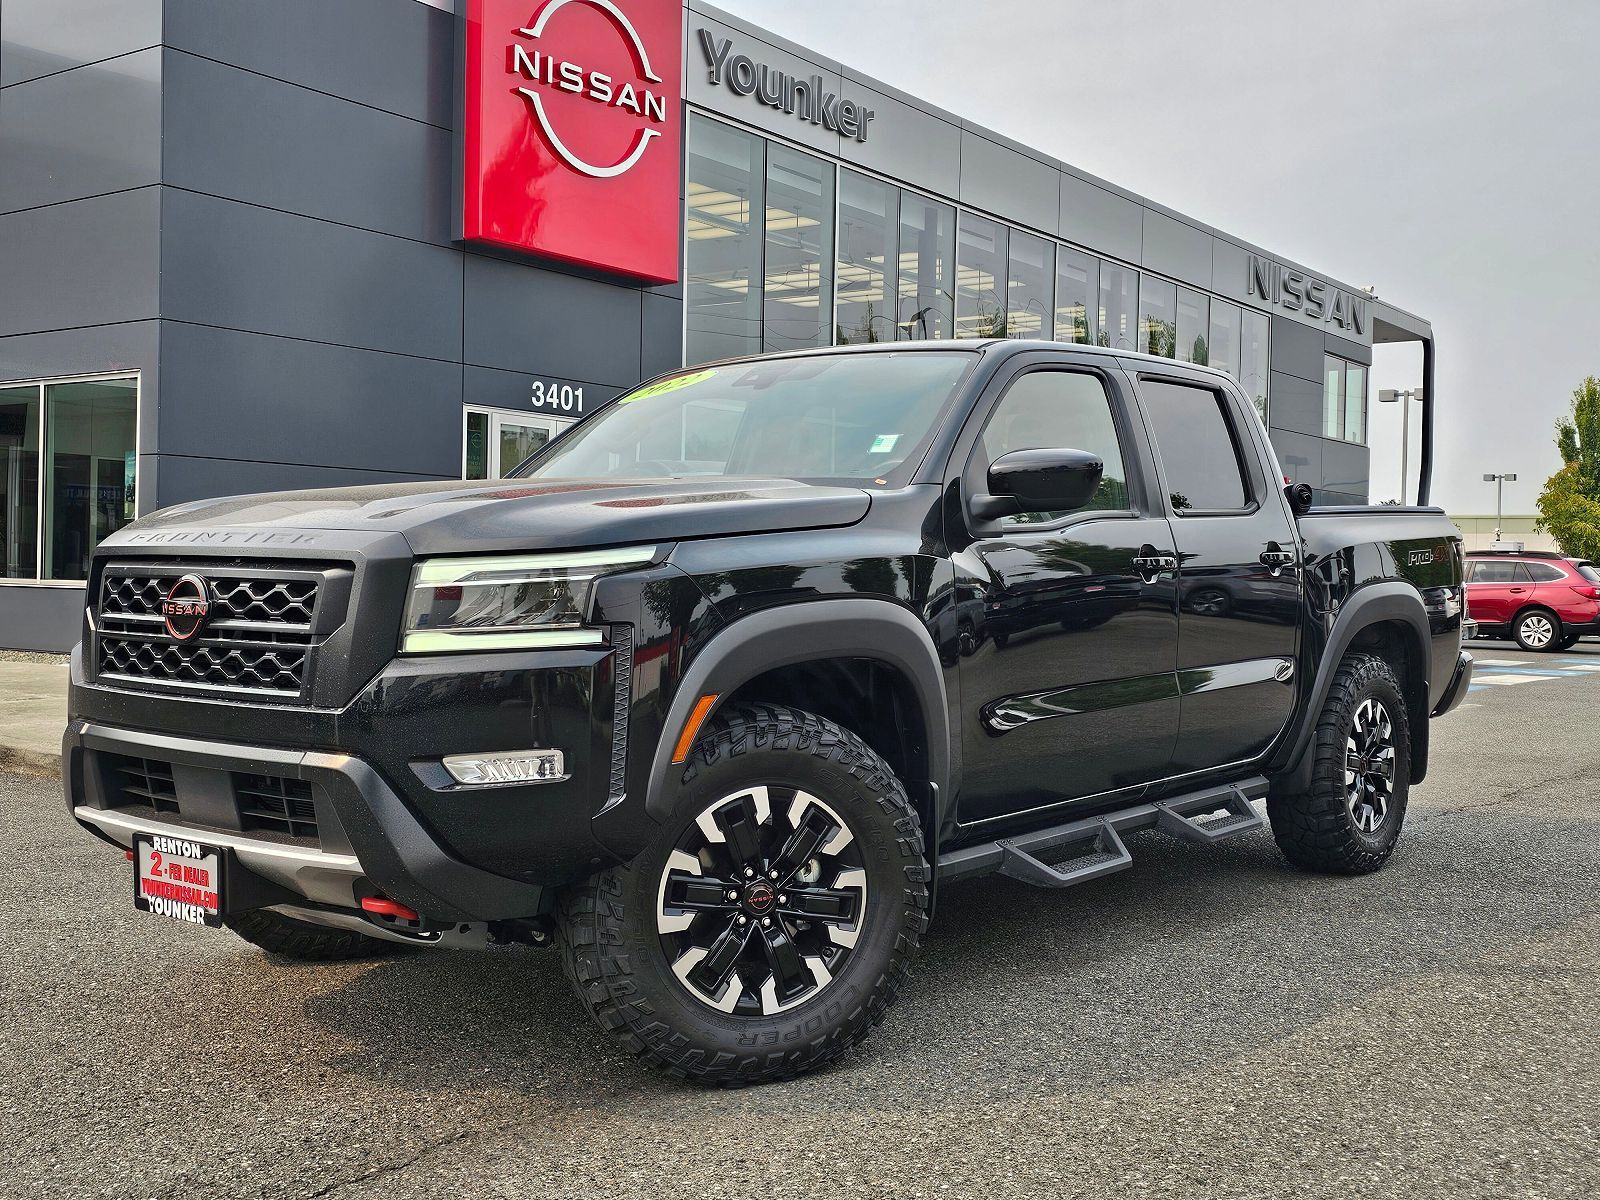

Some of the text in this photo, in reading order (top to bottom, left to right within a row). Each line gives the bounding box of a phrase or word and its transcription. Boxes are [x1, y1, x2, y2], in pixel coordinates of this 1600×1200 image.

[510, 43, 665, 122] NISSAN
[699, 28, 875, 142] Younker
[1248, 255, 1366, 334] NISSAN
[531, 380, 583, 412] 3401
[162, 600, 207, 616] NISSAN
[153, 836, 201, 858] RENTON
[183, 865, 210, 888] DEALER
[147, 895, 205, 925] YOUNKER
